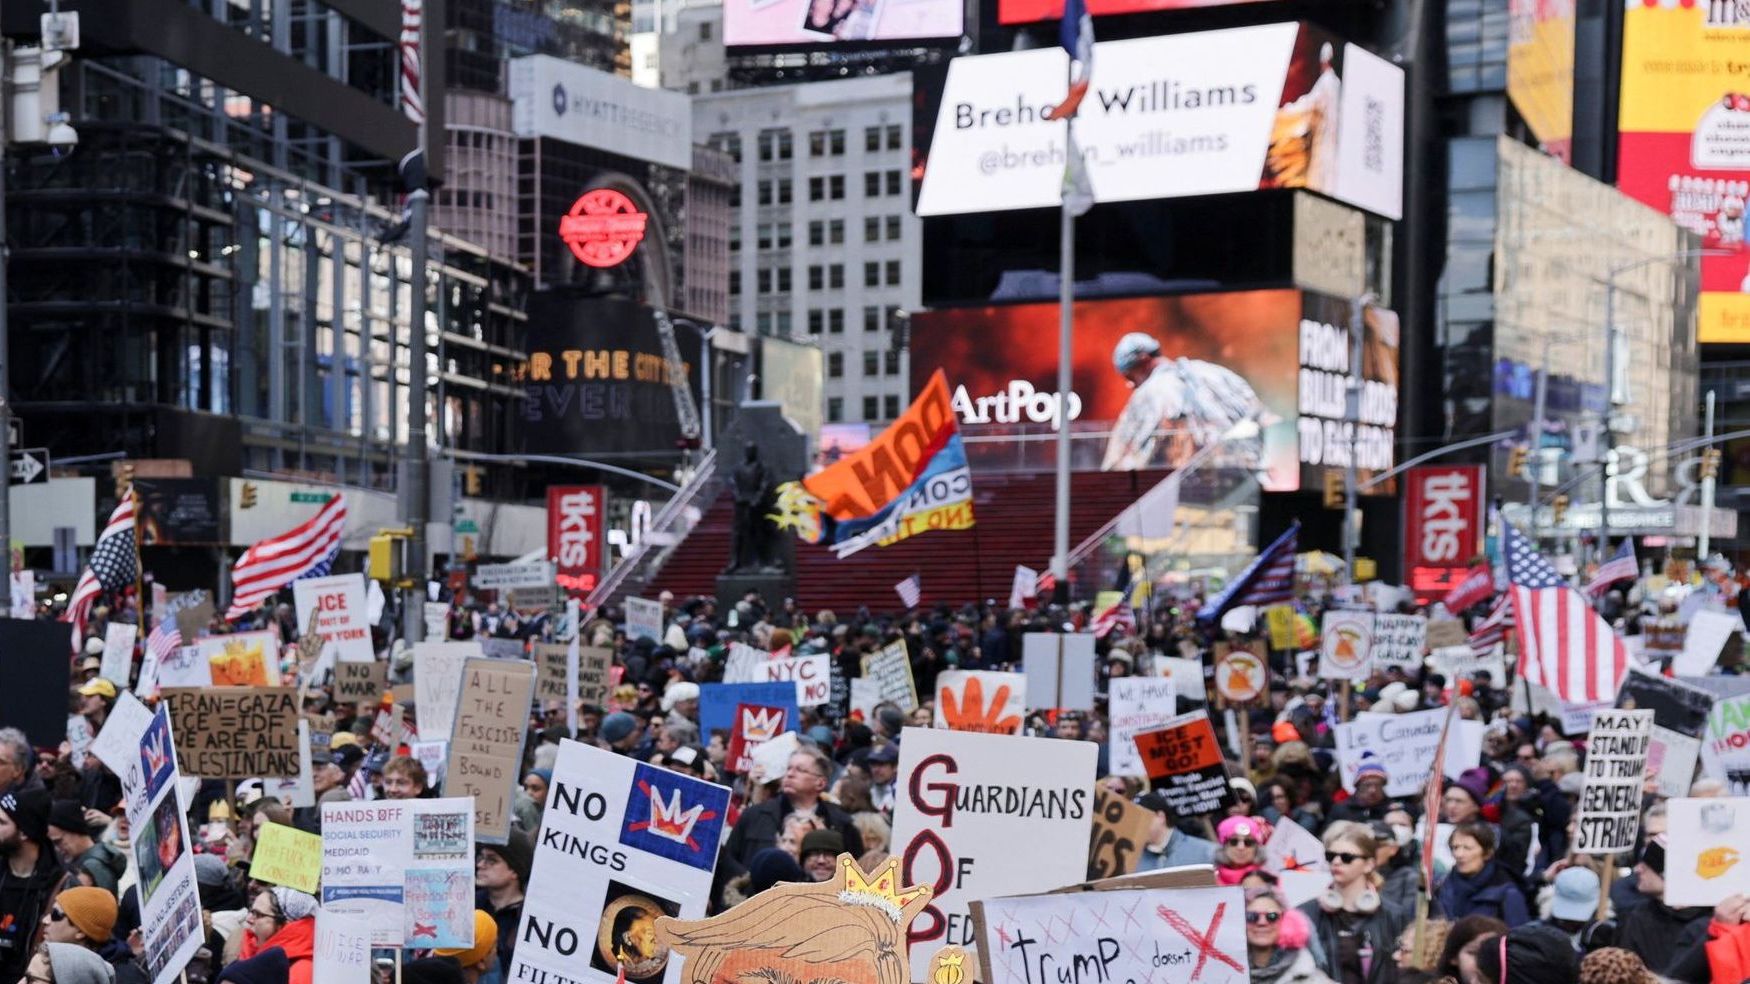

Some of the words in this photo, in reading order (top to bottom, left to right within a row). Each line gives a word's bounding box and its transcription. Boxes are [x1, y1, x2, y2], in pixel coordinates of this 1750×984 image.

[571, 95, 618, 124] HYATT
[955, 96, 1078, 131] Breho
[1098, 80, 1258, 116] Williams
[976, 130, 1229, 177] @brehn_williams
[1298, 318, 1349, 374] FROM
[561, 349, 630, 380] THE
[951, 378, 1082, 431] ArtPop
[1423, 471, 1471, 563] tkts
[559, 491, 596, 568] tkts
[316, 593, 347, 612] ICE
[320, 617, 339, 627] OUT
[341, 616, 351, 626] OF
[337, 628, 368, 641] YORK
[346, 666, 371, 679] NO
[767, 660, 817, 682] NYC
[338, 682, 377, 697] WAR
[471, 671, 513, 695] ALL
[804, 681, 827, 700] NO
[474, 698, 505, 719] THE
[170, 714, 211, 733] ICE
[1595, 716, 1644, 730] MAY
[204, 730, 248, 750] ARE
[255, 731, 293, 750] ALL
[1154, 727, 1188, 742] ICE
[1592, 735, 1637, 755] STAND
[1150, 735, 1206, 760] MUST
[172, 750, 301, 778] ALESTINIANS
[1164, 753, 1200, 771] GO!
[1589, 759, 1606, 777] TO
[551, 781, 607, 822] NO
[908, 753, 1087, 829] GUARDIANS
[323, 809, 374, 824] HANDS
[323, 829, 358, 841] SOCIAL
[358, 828, 402, 841] SECURITY
[1578, 816, 1637, 851] STRIKE!
[323, 847, 370, 857] MEDICAID
[542, 826, 628, 873] KINGS
[903, 829, 976, 899] OF
[523, 915, 578, 957] NO
